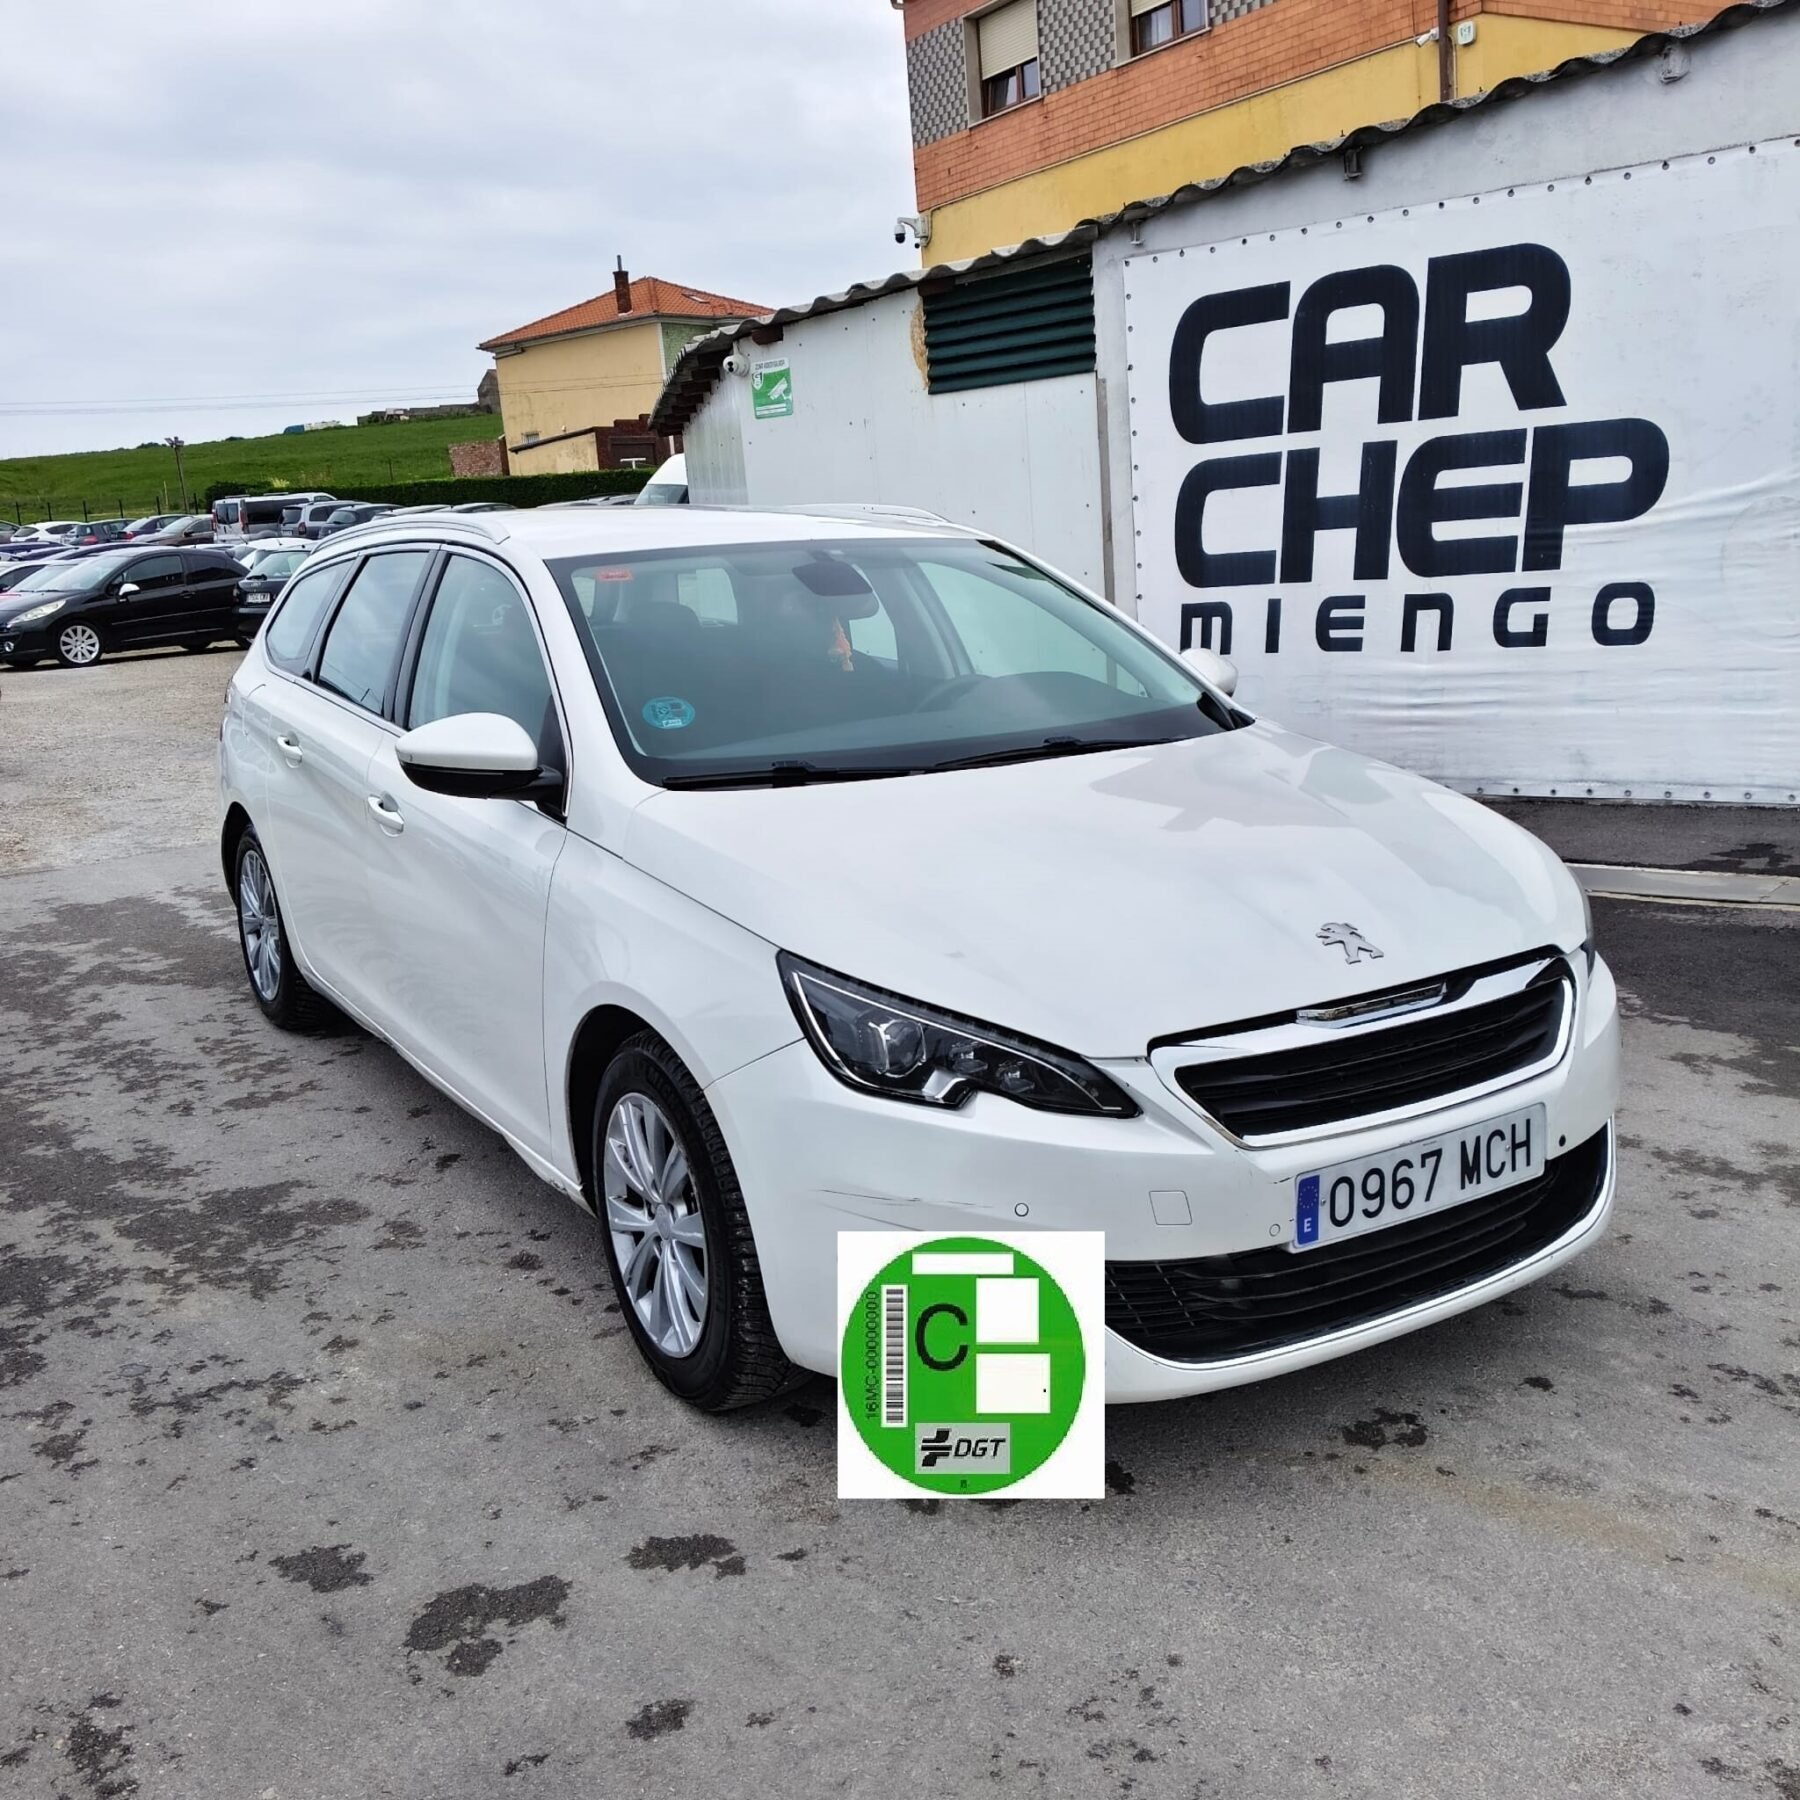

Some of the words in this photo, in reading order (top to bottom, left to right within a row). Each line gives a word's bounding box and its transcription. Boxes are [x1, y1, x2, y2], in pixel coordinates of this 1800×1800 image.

[1169, 243, 1571, 444] CAR
[1174, 418, 1669, 588] CHEP
[1180, 581, 1655, 655] MIENGO
[1303, 1217, 1312, 1233] E
[1329, 1147, 1443, 1228] 0967
[1460, 1118, 1532, 1190] MCH
